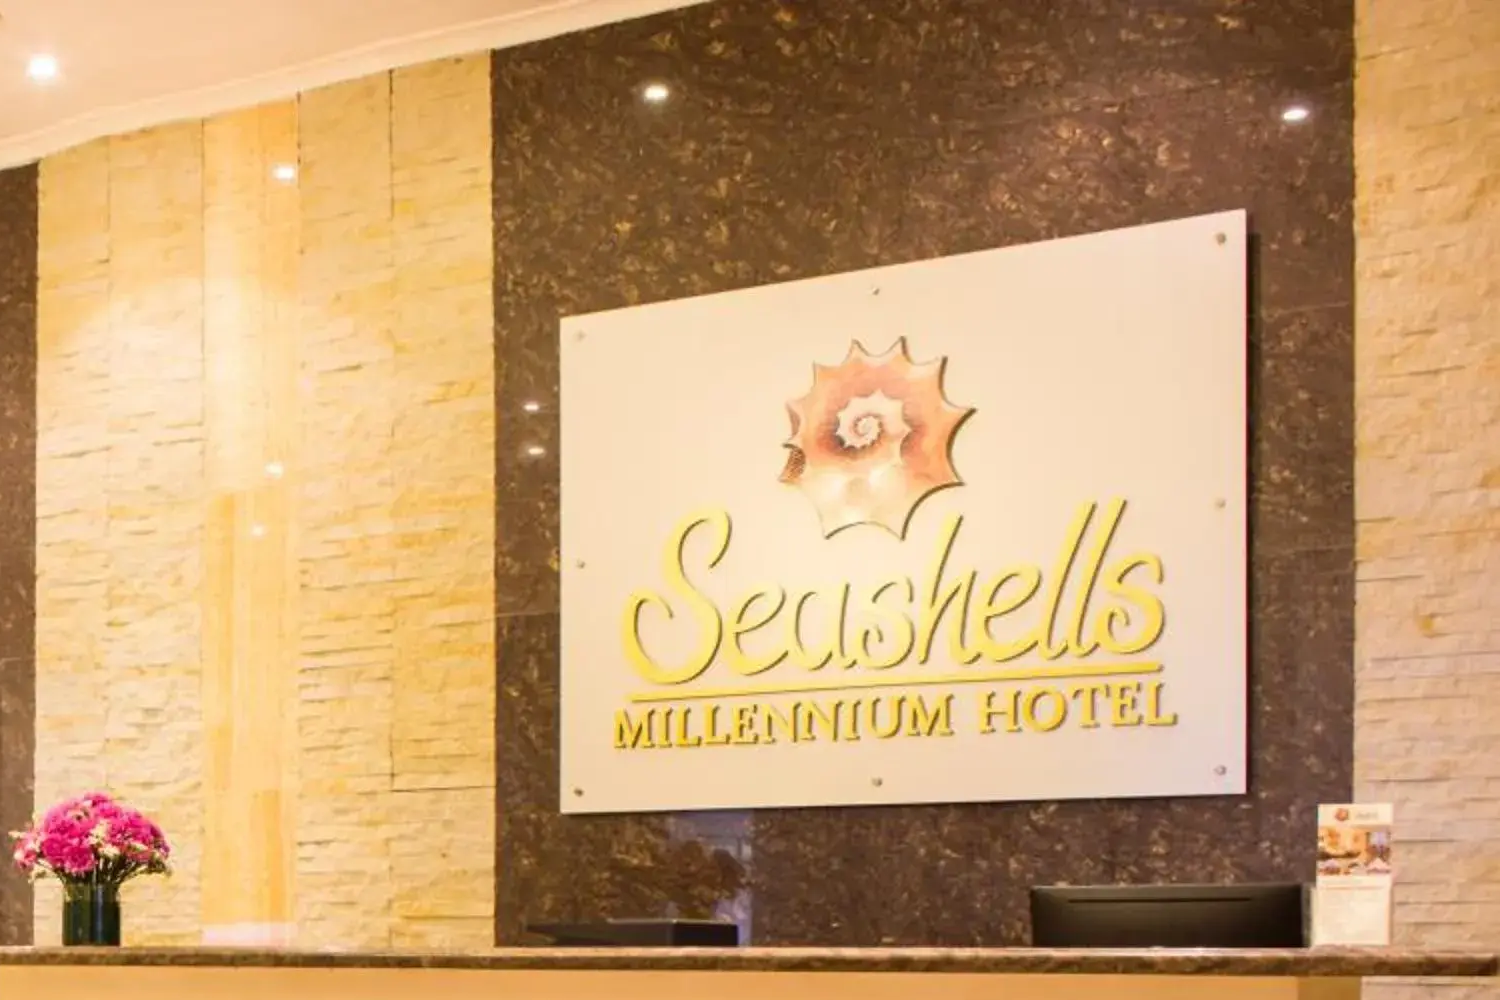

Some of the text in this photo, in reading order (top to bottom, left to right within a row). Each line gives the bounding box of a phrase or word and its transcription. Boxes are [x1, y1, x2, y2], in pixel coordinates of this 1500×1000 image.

[620, 497, 1167, 686] Seashells
[612, 681, 1179, 751] MILLENNIUM HOTEL
